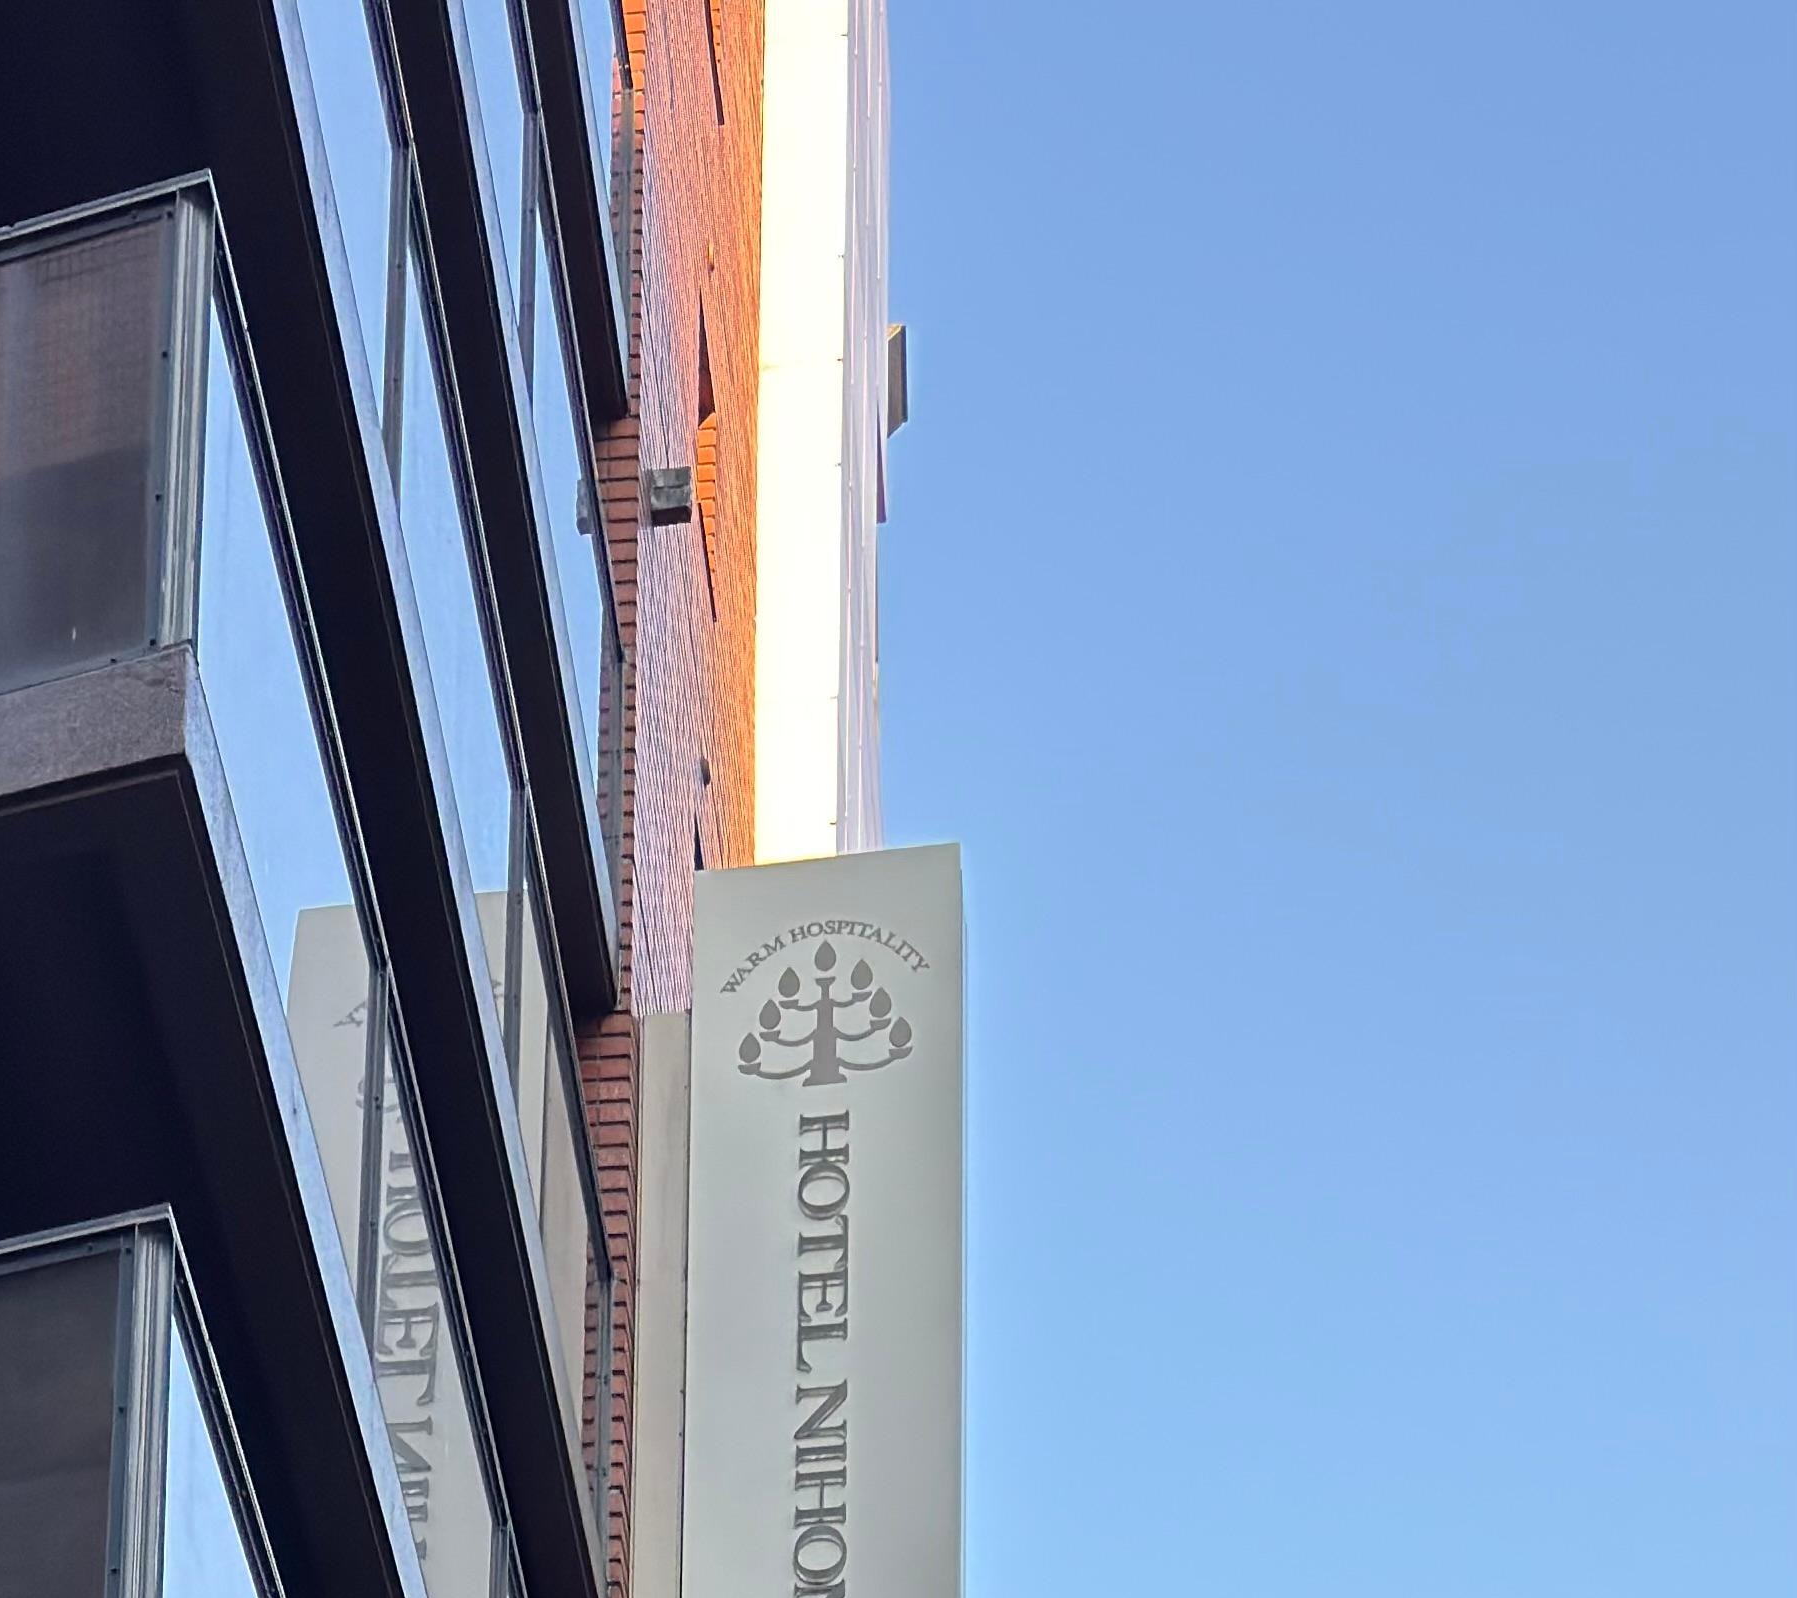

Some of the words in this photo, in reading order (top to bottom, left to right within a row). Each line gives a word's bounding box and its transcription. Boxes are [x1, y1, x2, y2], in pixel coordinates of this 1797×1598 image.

[720, 935, 786, 994] WARM
[788, 920, 931, 973] HOSPITALITY
[795, 1110, 851, 1374] HOTEL
